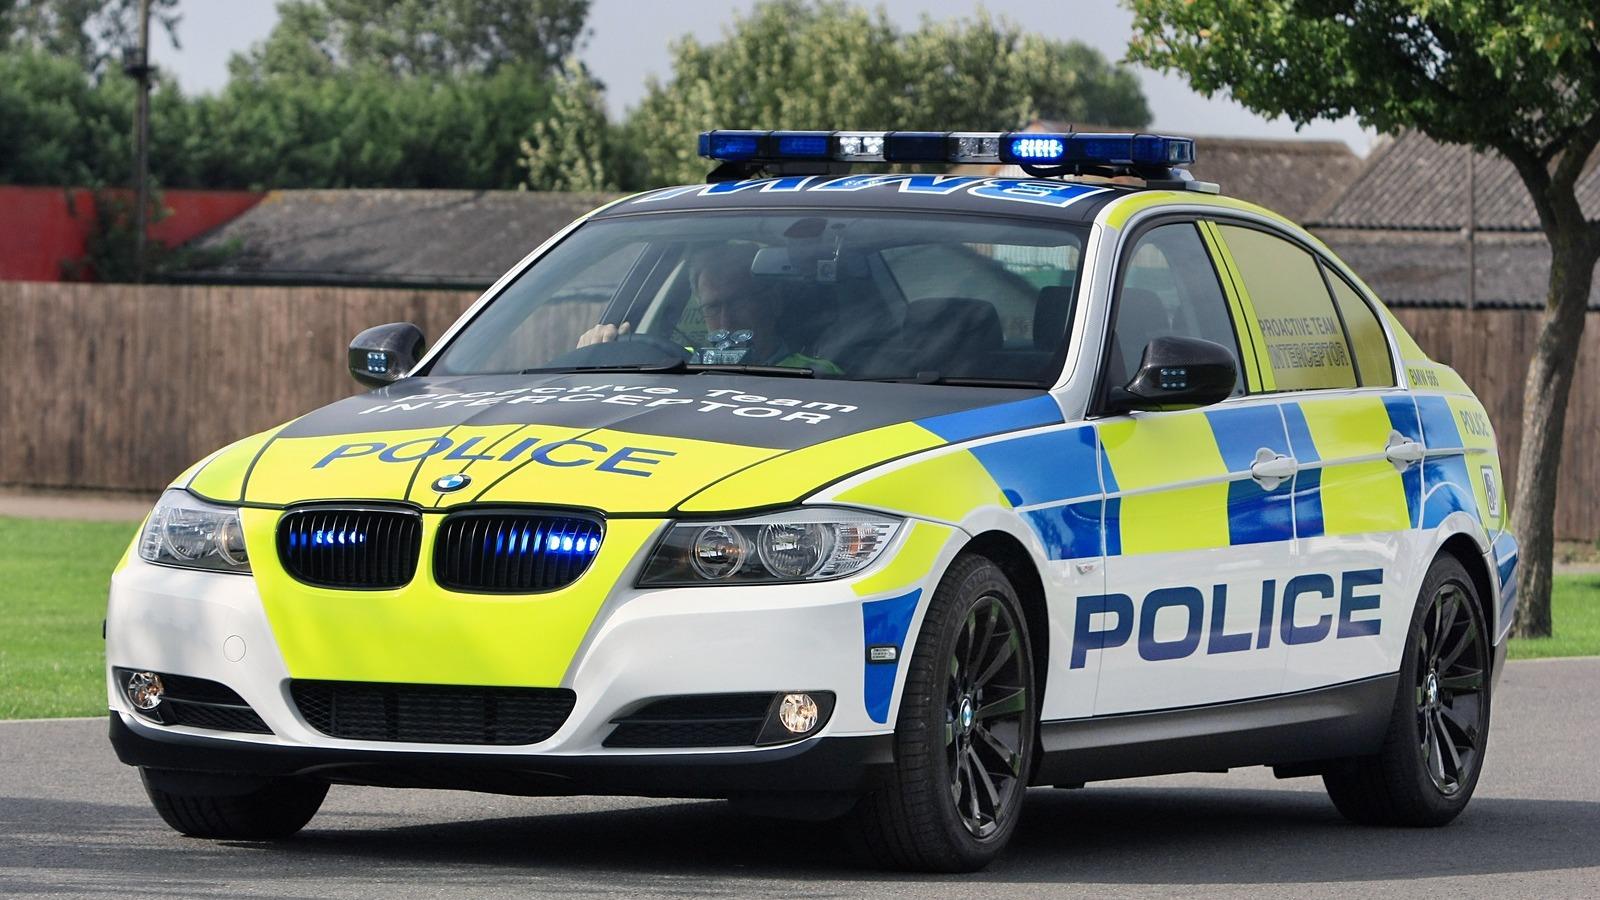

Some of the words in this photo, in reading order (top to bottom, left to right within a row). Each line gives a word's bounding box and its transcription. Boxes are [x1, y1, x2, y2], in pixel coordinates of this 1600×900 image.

[1259, 318, 1313, 337] PROACTIVE
[1310, 316, 1338, 335] TEAM
[1267, 341, 1350, 369] INTERCEPTOR
[1408, 368, 1429, 387] BMW
[357, 393, 832, 425] INTERCEPTOR
[706, 388, 859, 413] Team
[1458, 409, 1491, 438] POLICE
[311, 436, 678, 478] POLICE
[1069, 567, 1384, 670] POLICE
